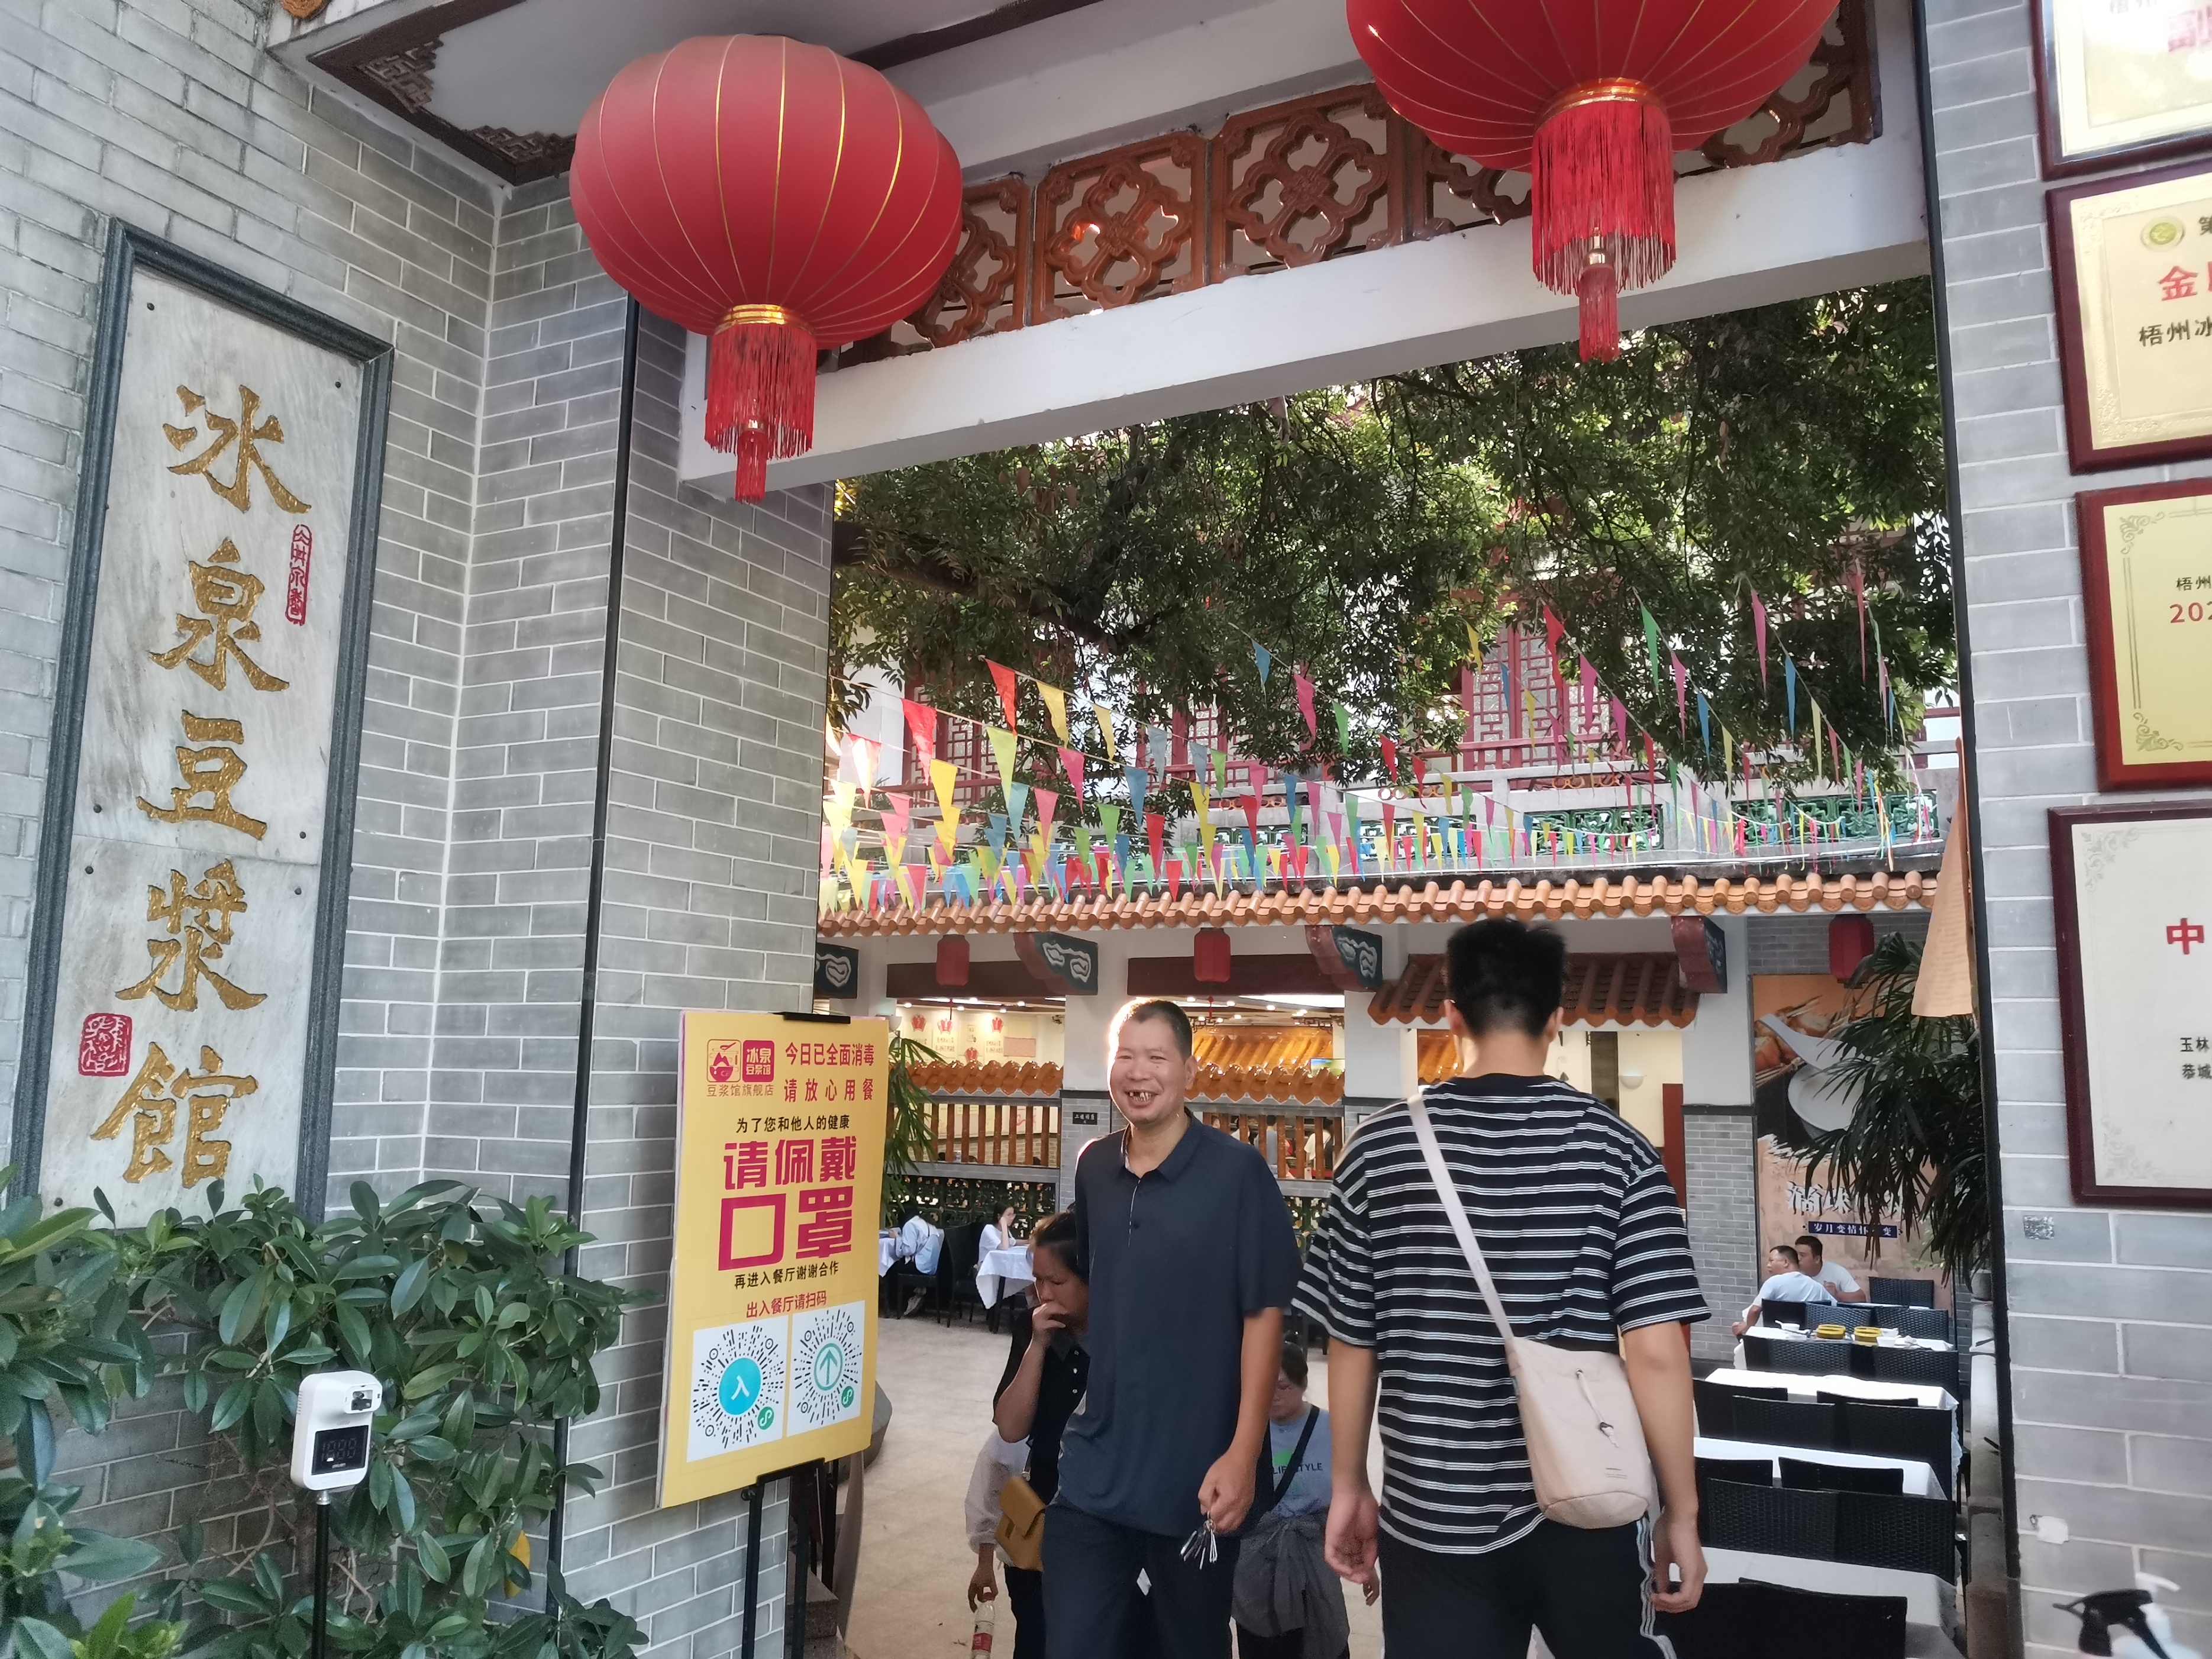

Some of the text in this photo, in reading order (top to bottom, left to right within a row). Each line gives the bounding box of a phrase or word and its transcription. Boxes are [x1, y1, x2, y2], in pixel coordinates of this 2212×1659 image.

[2158, 261, 2212, 301] 金
[2176, 574, 2211, 591] 梧州
[2166, 918, 2204, 954] 中
[747, 1047, 771, 1064] 冰泉
[784, 1042, 874, 1066] 今日已全面消毒
[2179, 1036, 2210, 1052] 玉林
[746, 1064, 771, 1076] 豆浆馆
[706, 1084, 774, 1097] 豆浆馆旗舰店
[784, 1078, 874, 1103] 请放心用餐
[736, 1115, 850, 1133] 为了您和他人的健康
[724, 1135, 857, 1190] 请佩戴
[718, 1186, 854, 1271] 口罩
[1814, 1222, 1893, 1237] 岁月变情怀变
[734, 1261, 839, 1290] 再进入餐厅谢谢合作
[746, 1290, 827, 1319] 出入餐厅请扫码
